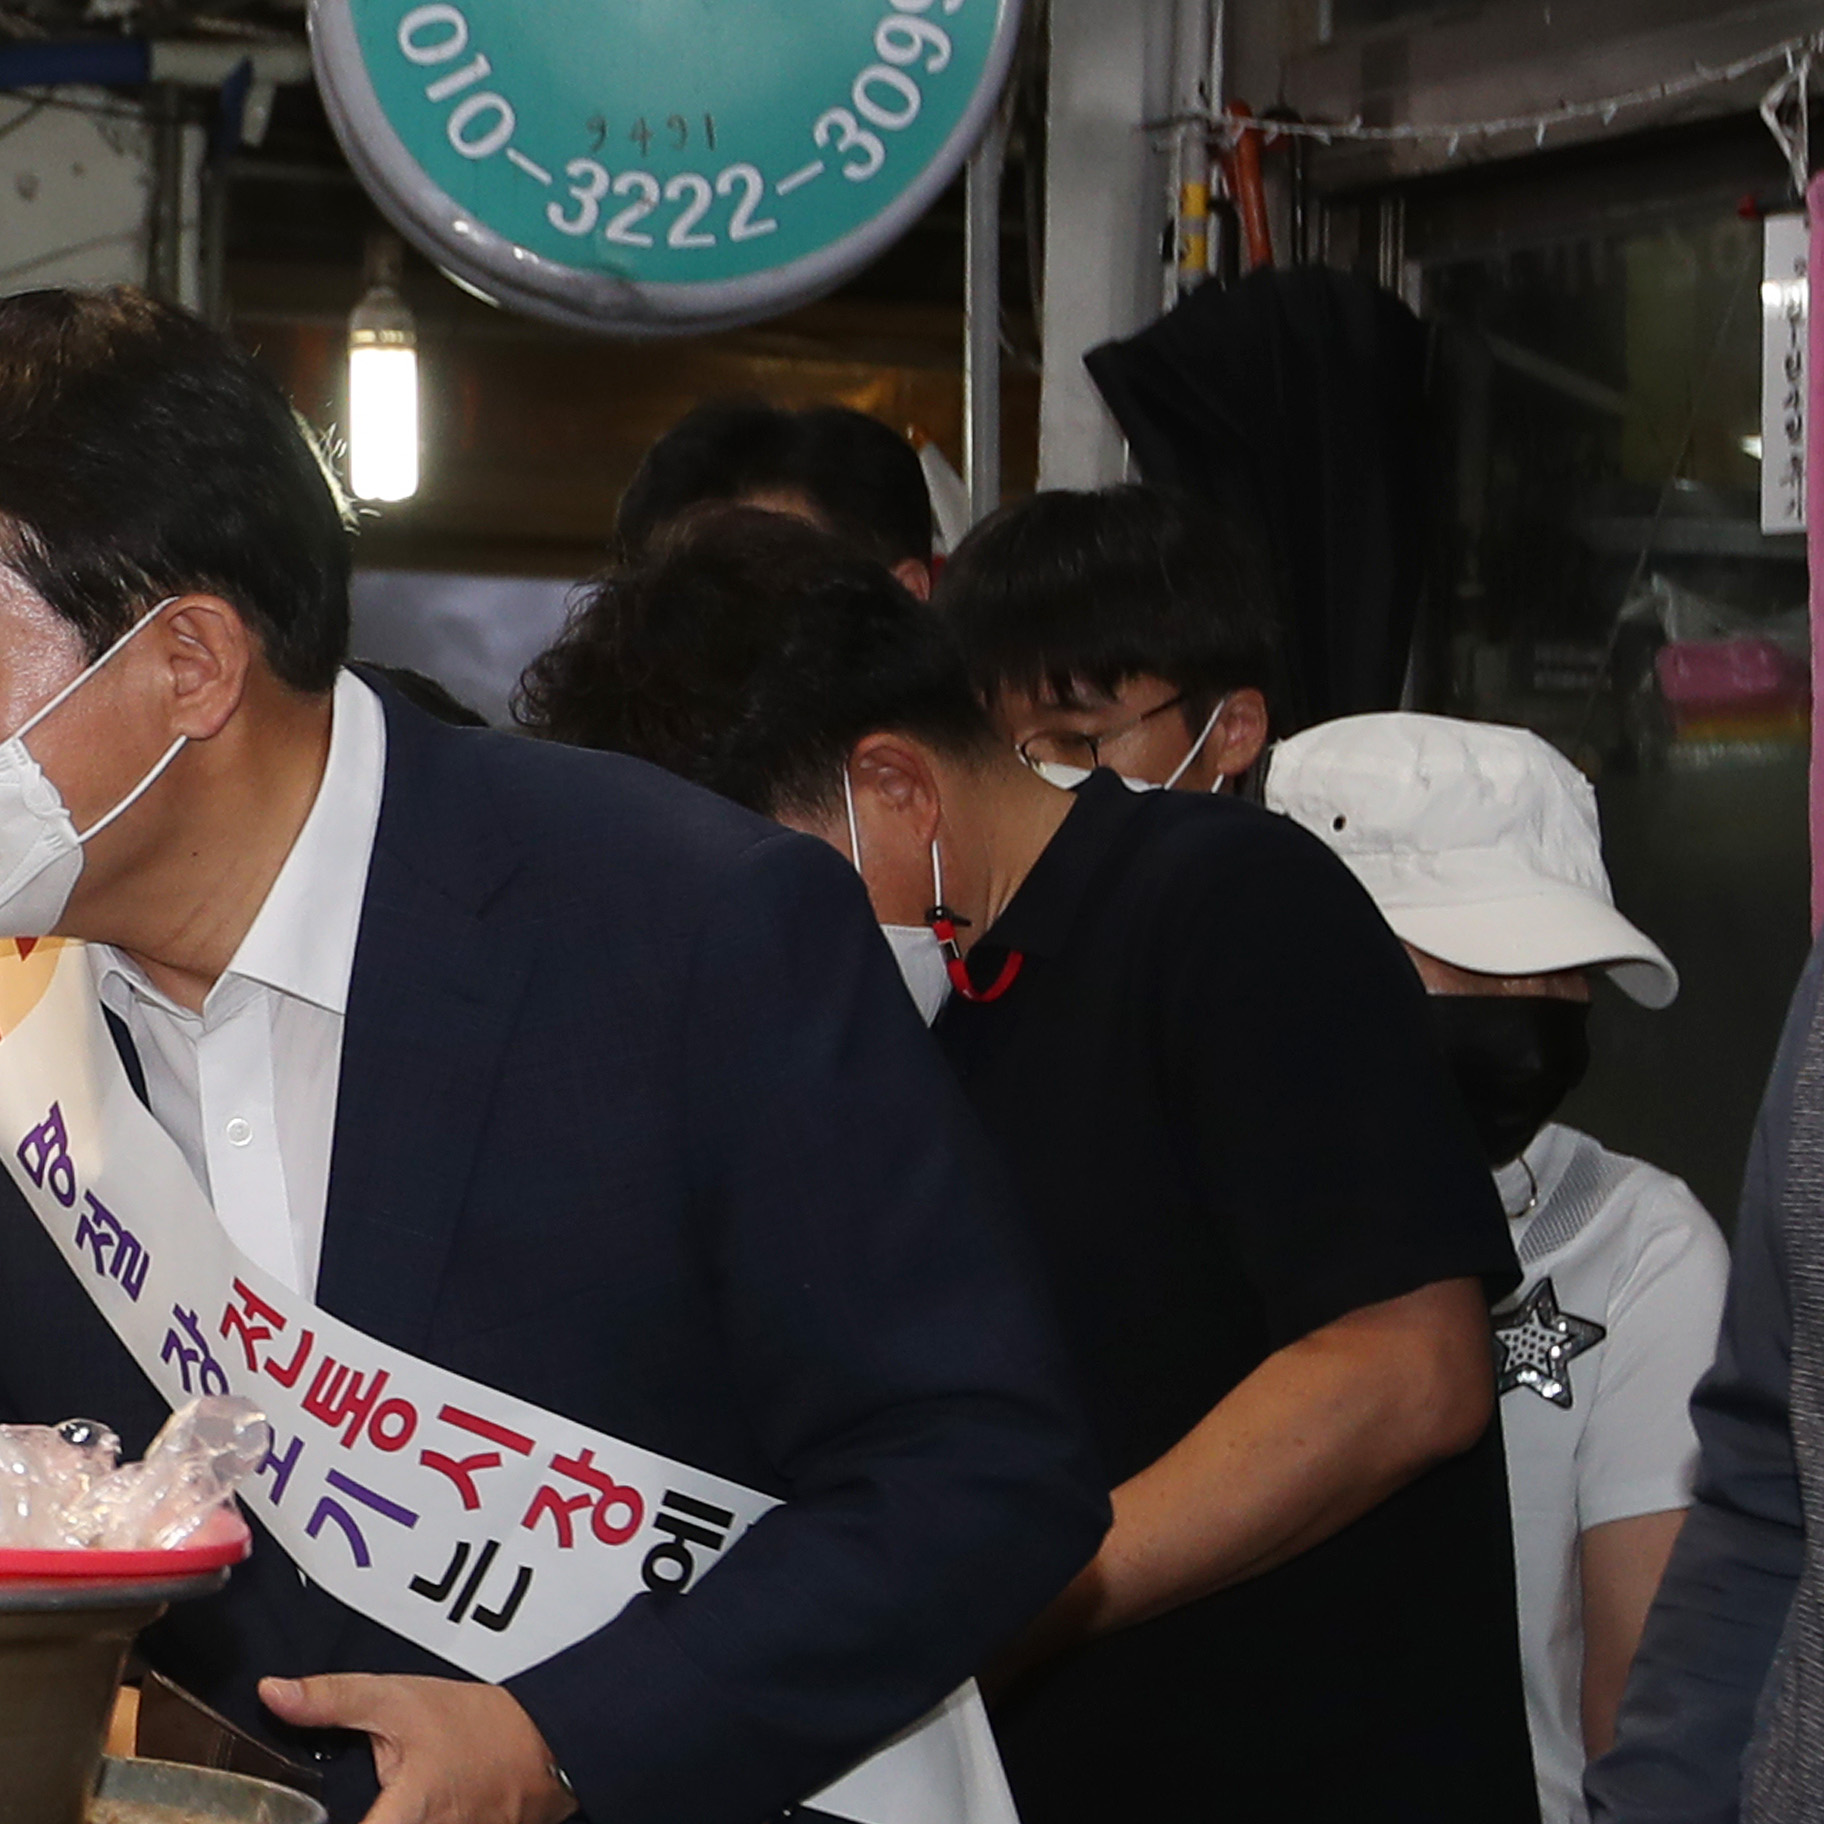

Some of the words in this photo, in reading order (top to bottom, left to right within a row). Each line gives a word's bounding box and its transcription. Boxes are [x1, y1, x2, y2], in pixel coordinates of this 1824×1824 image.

[397, 0, 965, 248] 010-3222-309
[16, 1101, 150, 1302] 명절
[219, 1278, 734, 1595] 전통시장에
